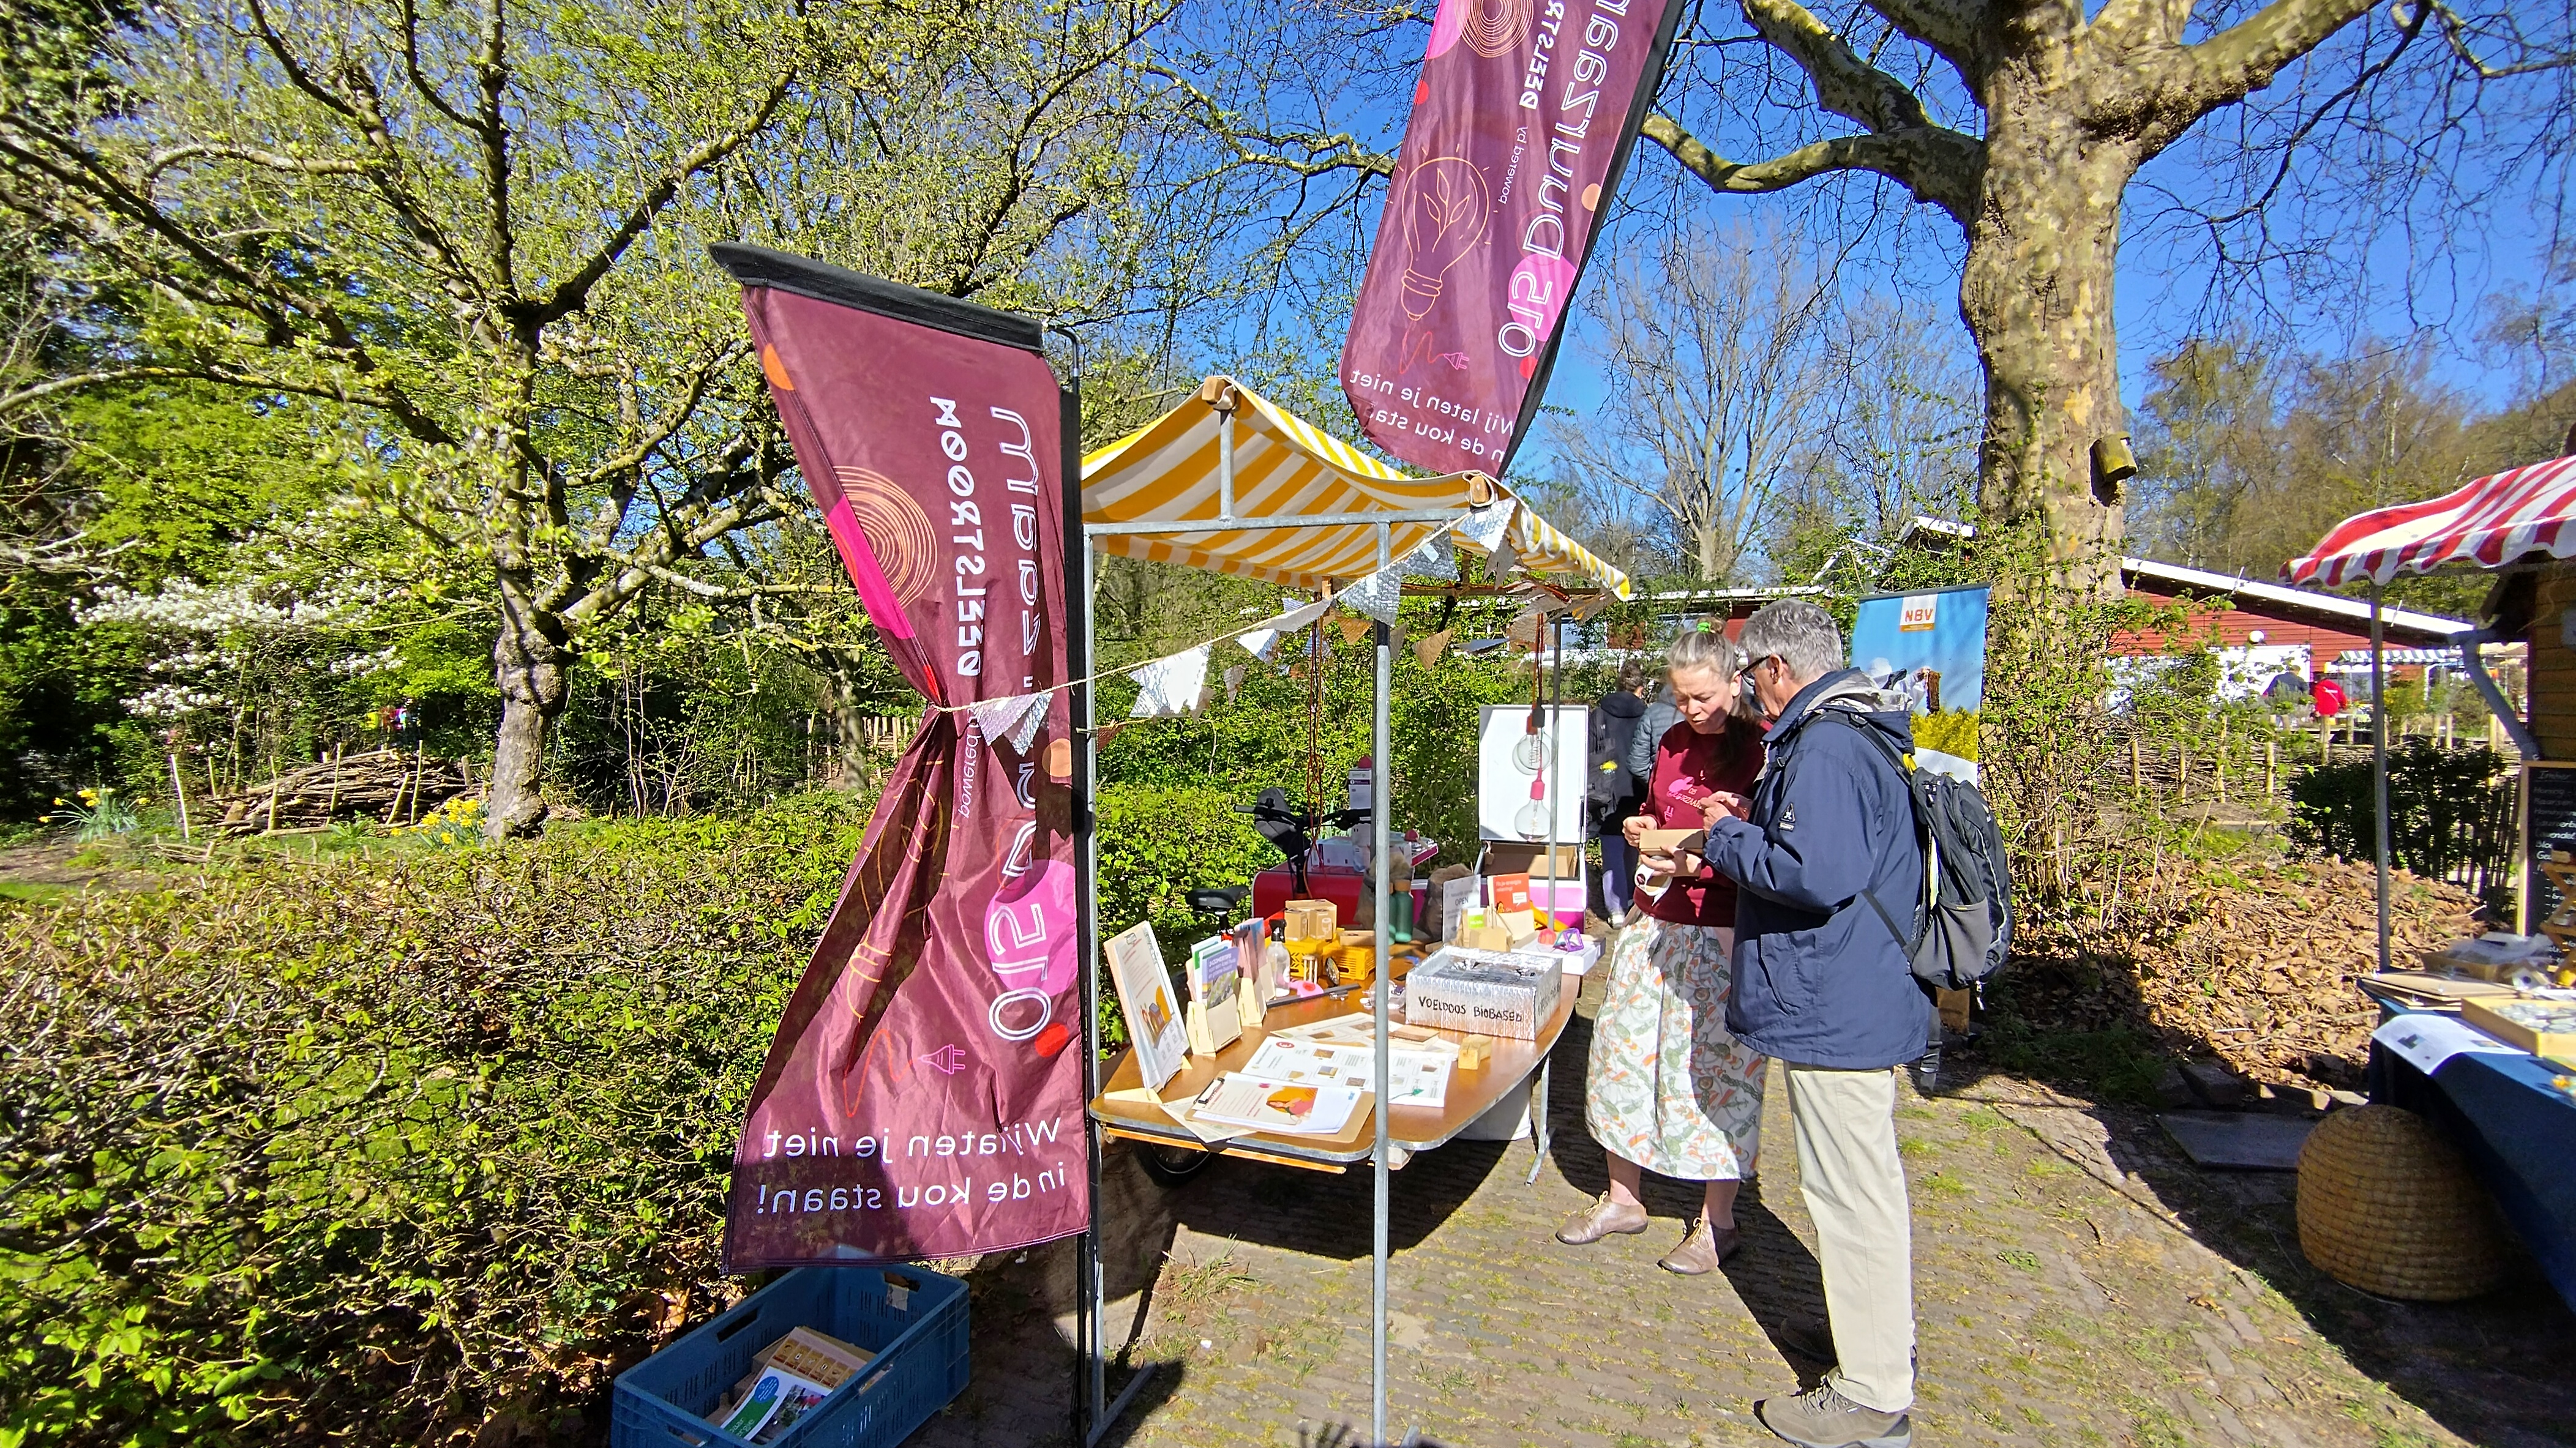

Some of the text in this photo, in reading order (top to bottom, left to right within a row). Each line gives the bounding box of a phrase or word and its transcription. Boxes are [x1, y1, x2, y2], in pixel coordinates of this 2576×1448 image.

[1904, 608, 1933, 623] NBV
[1455, 896, 1469, 906] OPEN
[1418, 996, 1466, 1015] VOELDOOS
